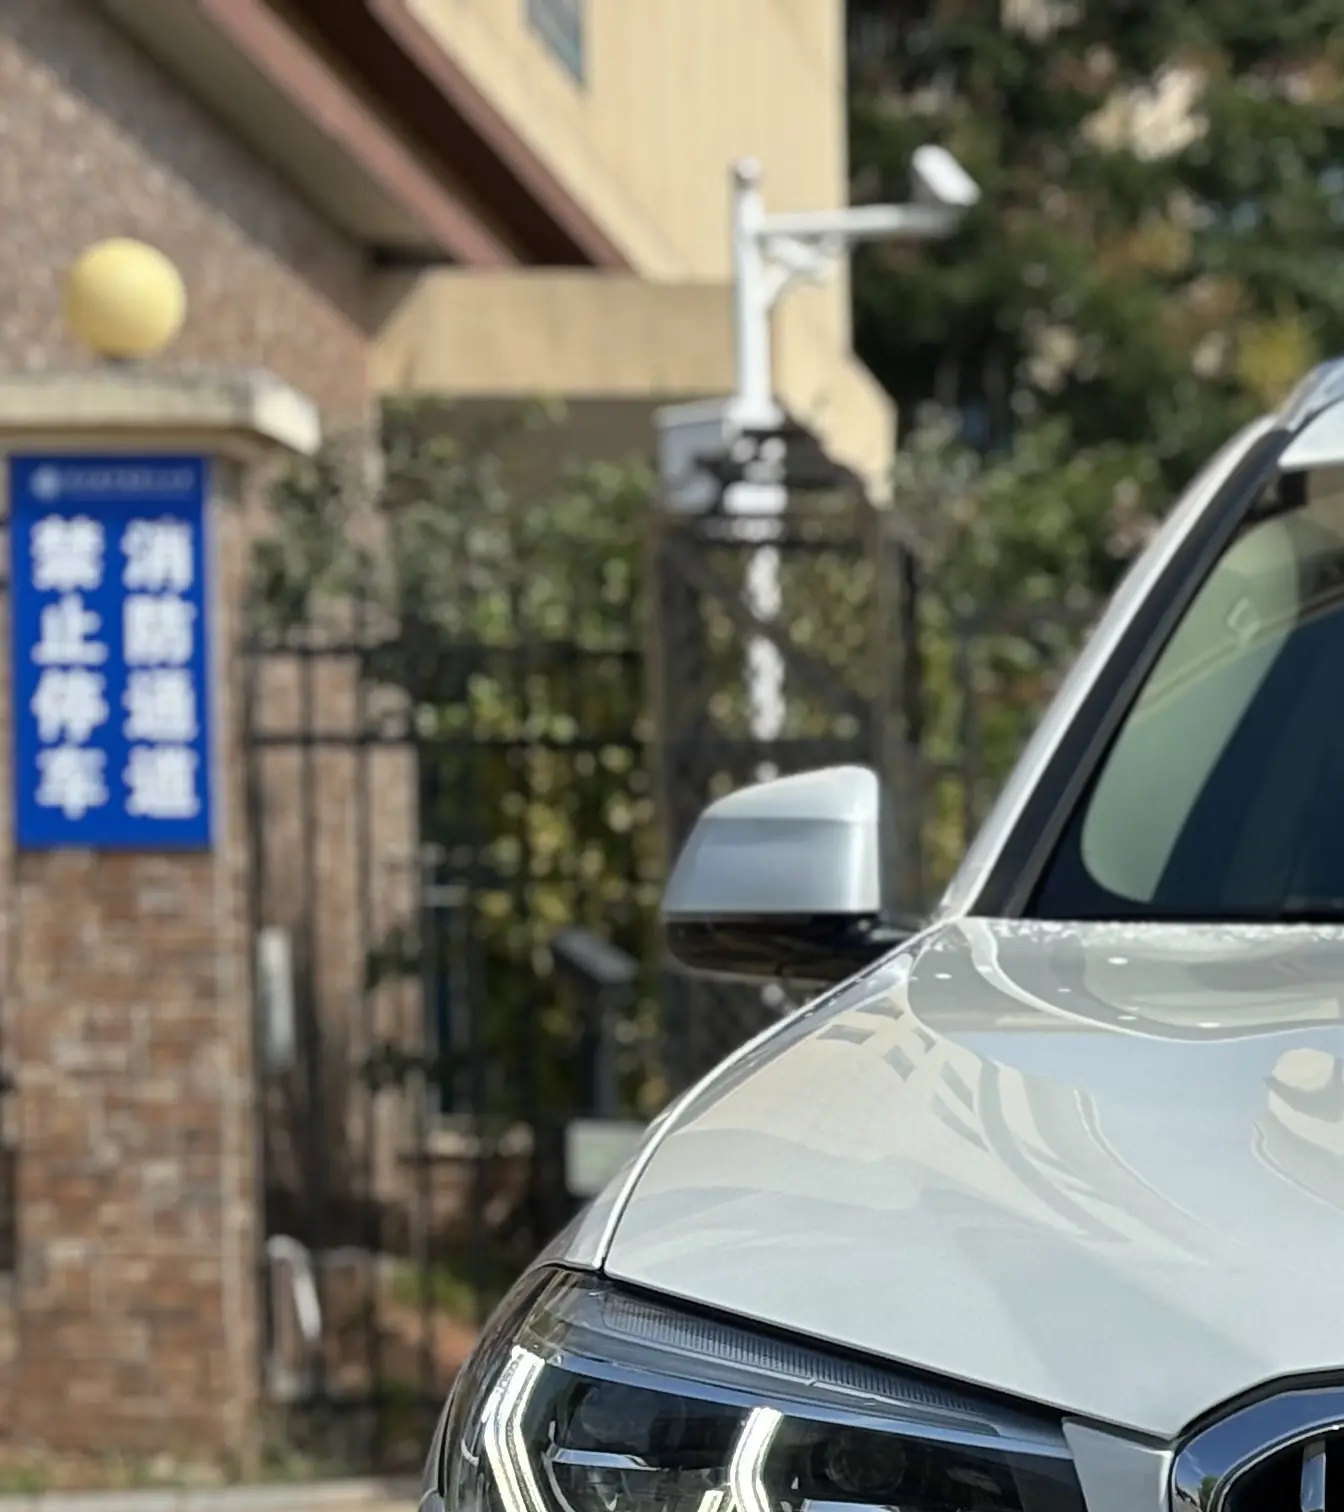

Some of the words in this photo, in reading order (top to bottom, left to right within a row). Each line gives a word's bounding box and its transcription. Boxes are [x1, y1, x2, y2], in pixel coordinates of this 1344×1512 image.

[30, 515, 109, 821] 禁止停车
[121, 517, 200, 819] 消防通道
